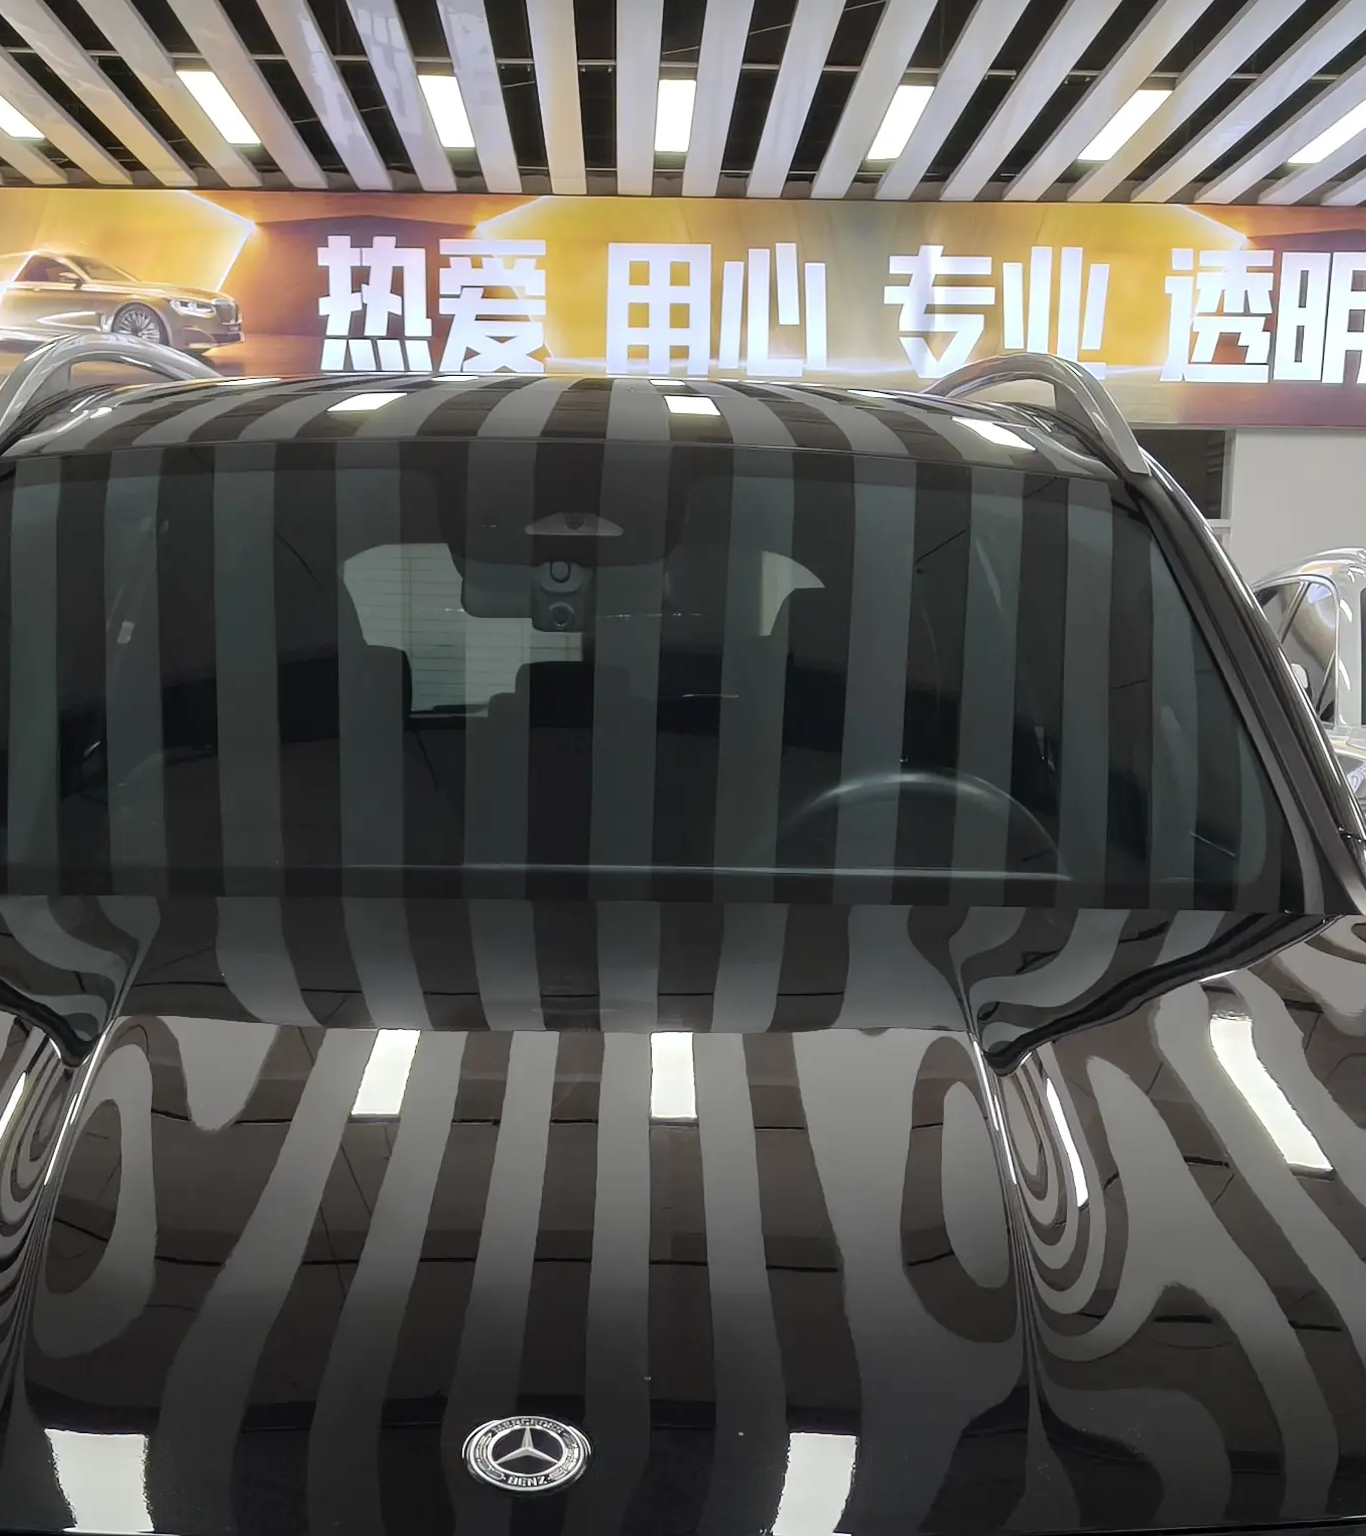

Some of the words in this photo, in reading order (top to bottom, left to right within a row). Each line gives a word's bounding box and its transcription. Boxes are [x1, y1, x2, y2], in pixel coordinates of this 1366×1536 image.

[317, 235, 546, 373] 热爱
[606, 243, 827, 376] 用心
[884, 245, 1110, 380] 专业
[507, 1475, 548, 1487] BENZ
